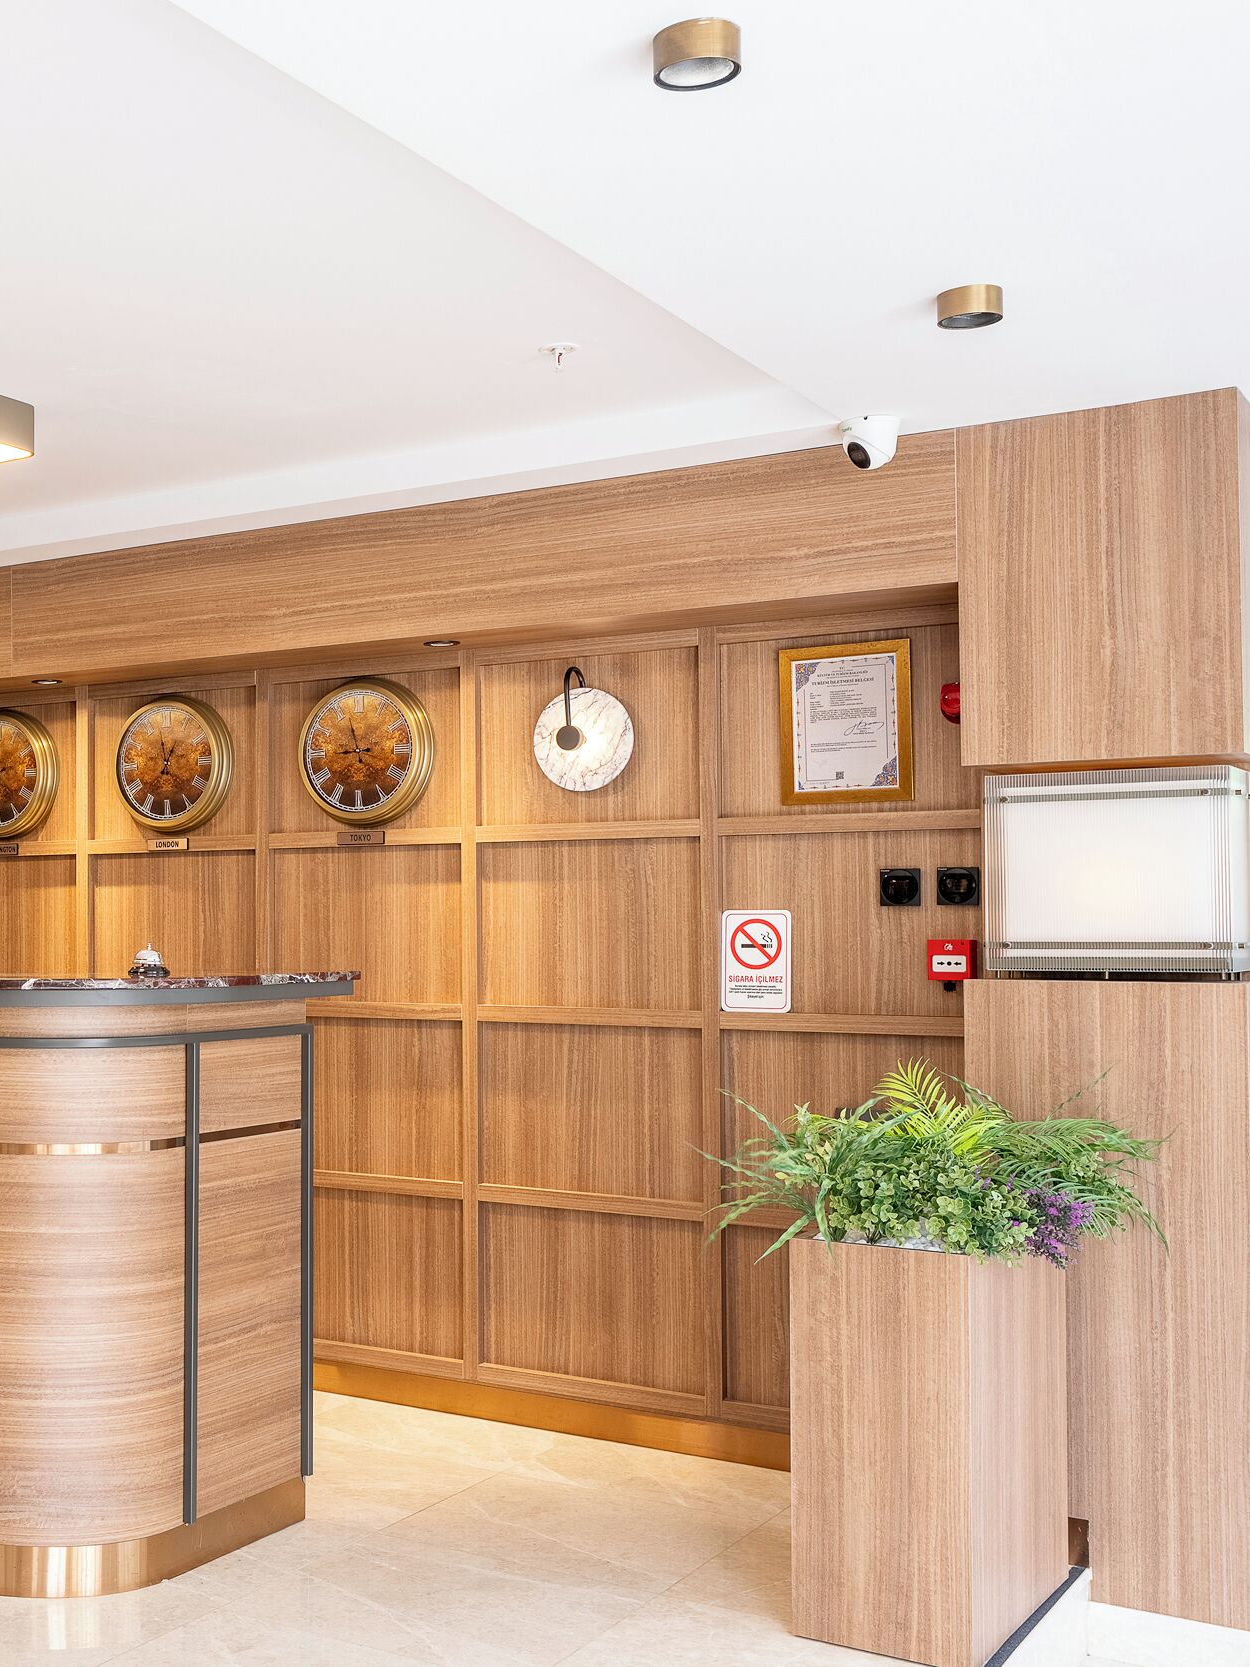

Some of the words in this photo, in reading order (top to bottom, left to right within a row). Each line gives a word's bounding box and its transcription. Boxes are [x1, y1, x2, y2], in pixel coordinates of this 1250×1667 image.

[350, 834, 371, 842] TOKYO
[728, 974, 753, 983] SİGARA
[755, 974, 784, 985] İÇİLMEZ
